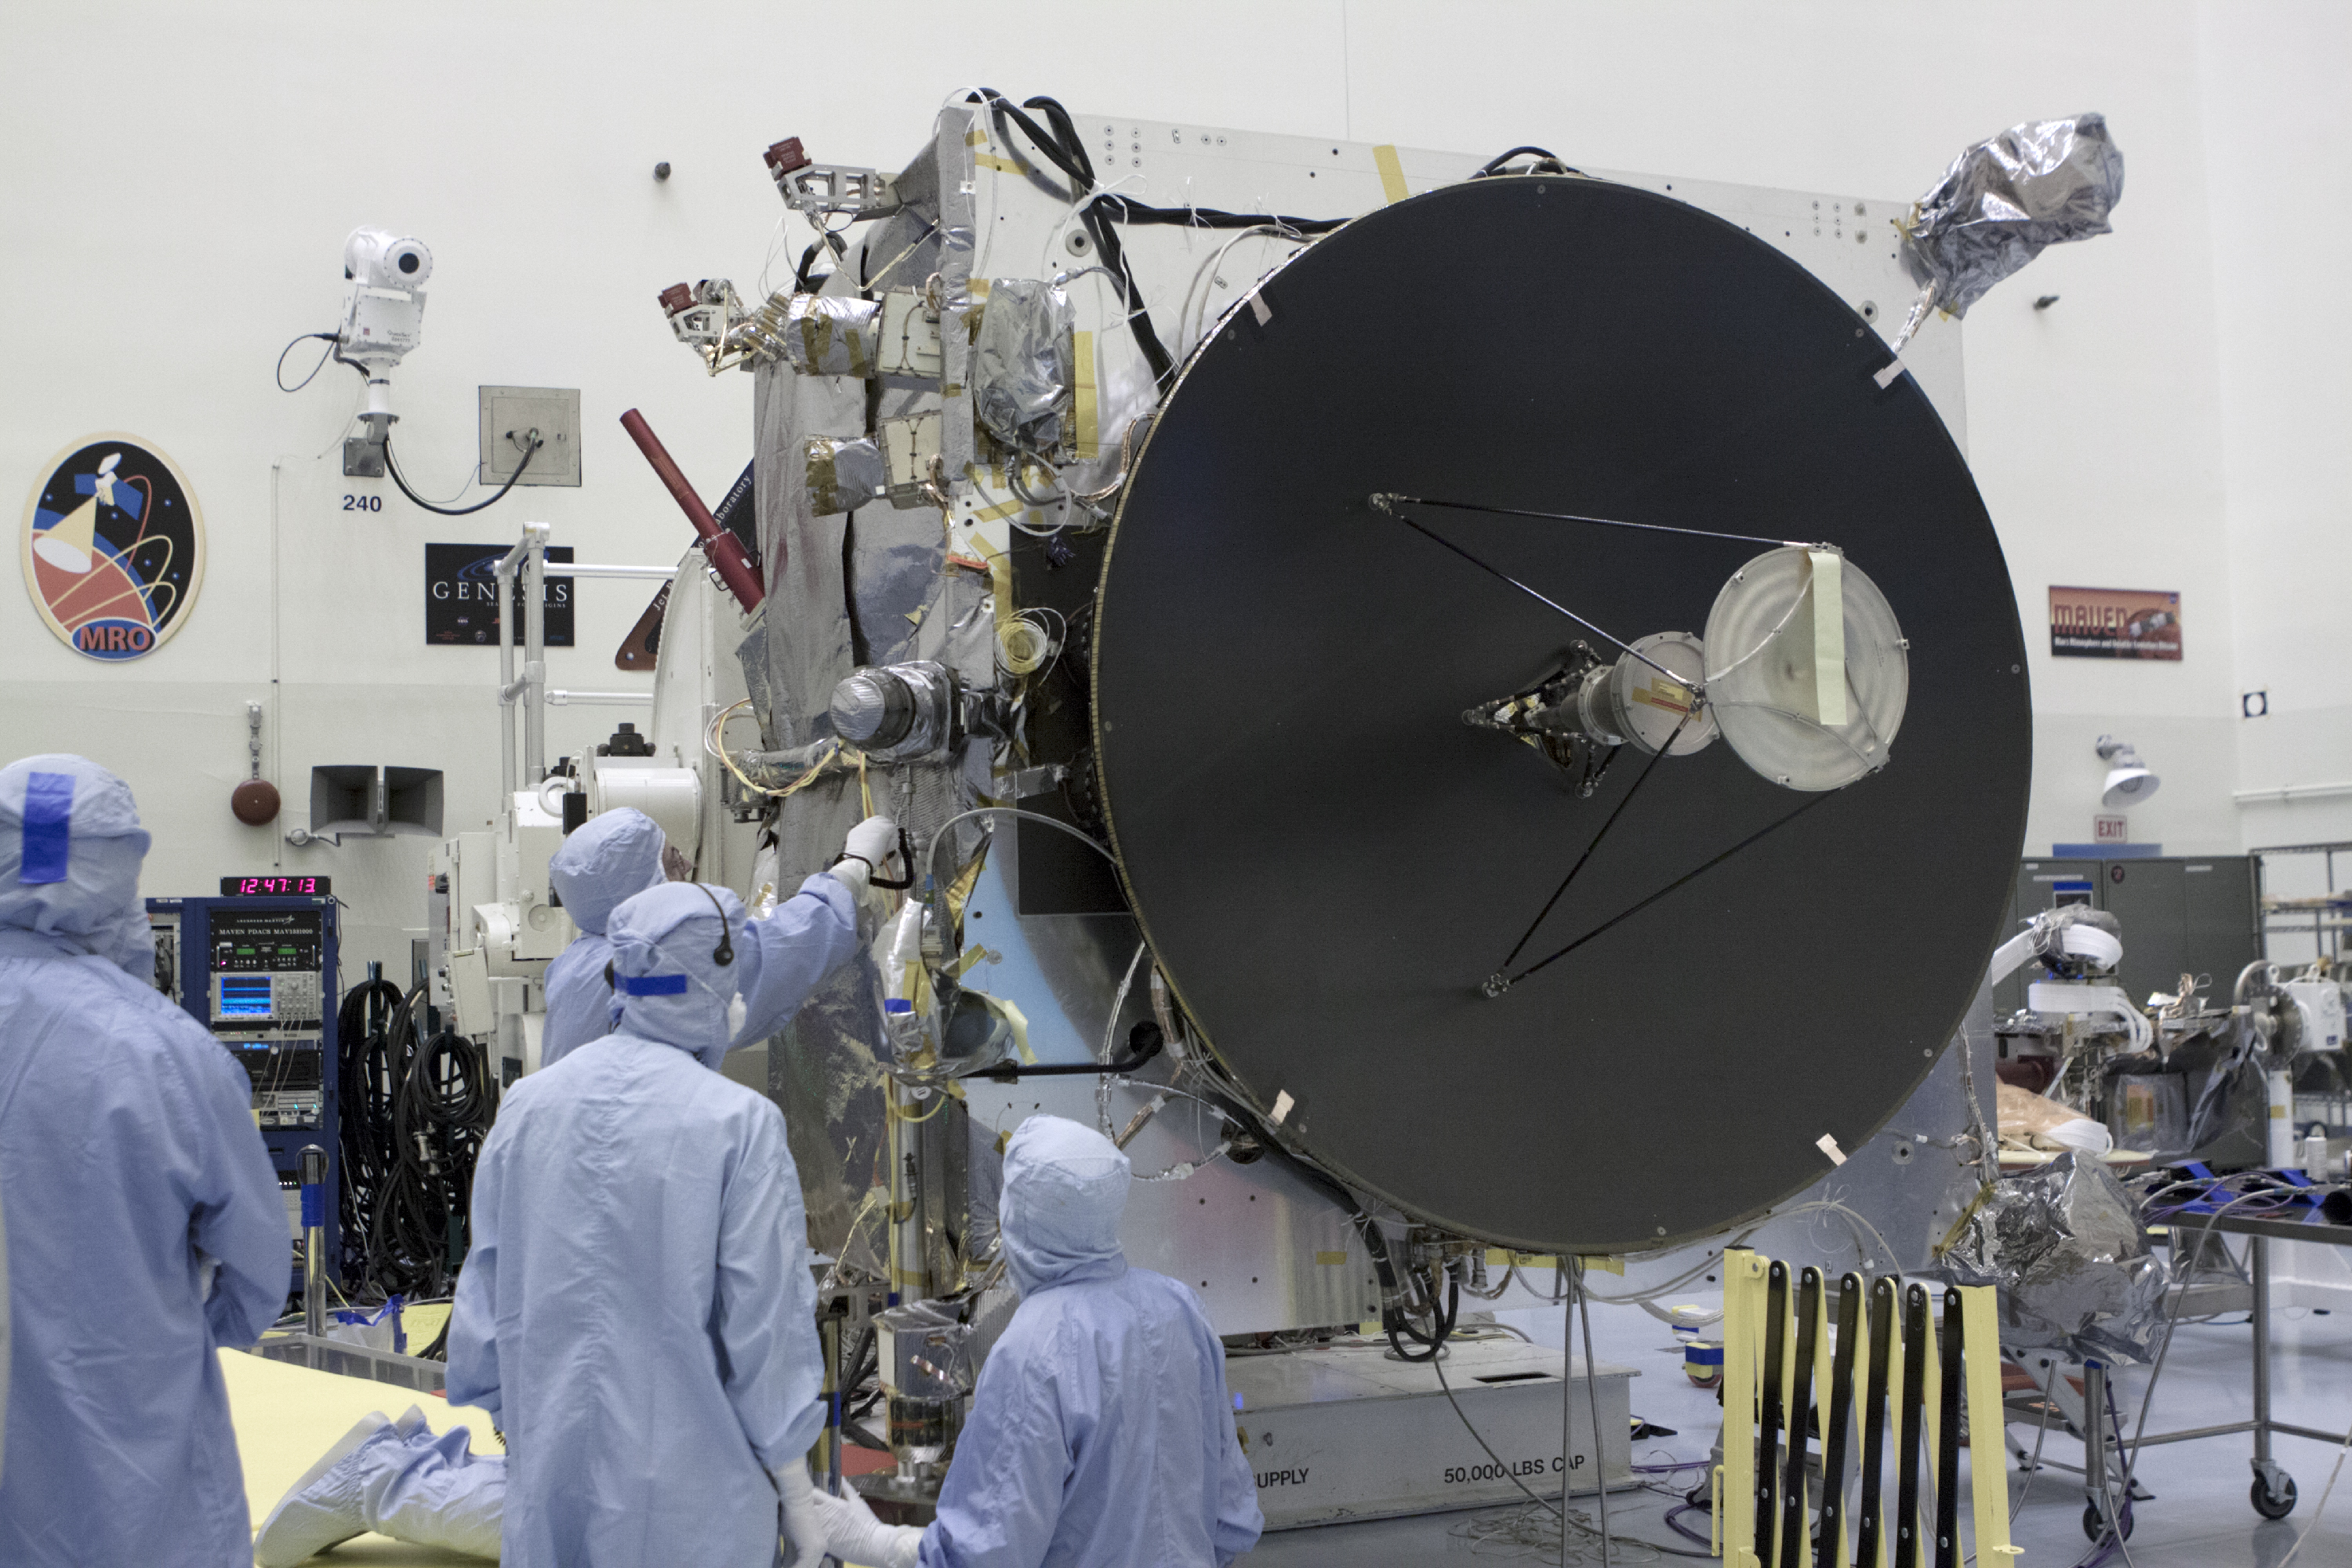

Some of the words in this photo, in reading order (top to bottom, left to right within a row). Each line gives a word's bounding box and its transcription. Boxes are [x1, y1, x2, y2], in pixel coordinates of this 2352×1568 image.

[343, 494, 382, 512] 240
[716, 475, 752, 524] aboratory
[433, 582, 567, 601] GENIS
[2055, 605, 2127, 636] MAVEN
[79, 626, 154, 652] MRO
[2099, 821, 2124, 837] EXIT
[241, 878, 315, 893] 12:47:13
[1254, 1468, 1309, 1488] UPPLY
[1444, 1465, 1504, 1484] 50,000
[1513, 1459, 1544, 1476] LBS
